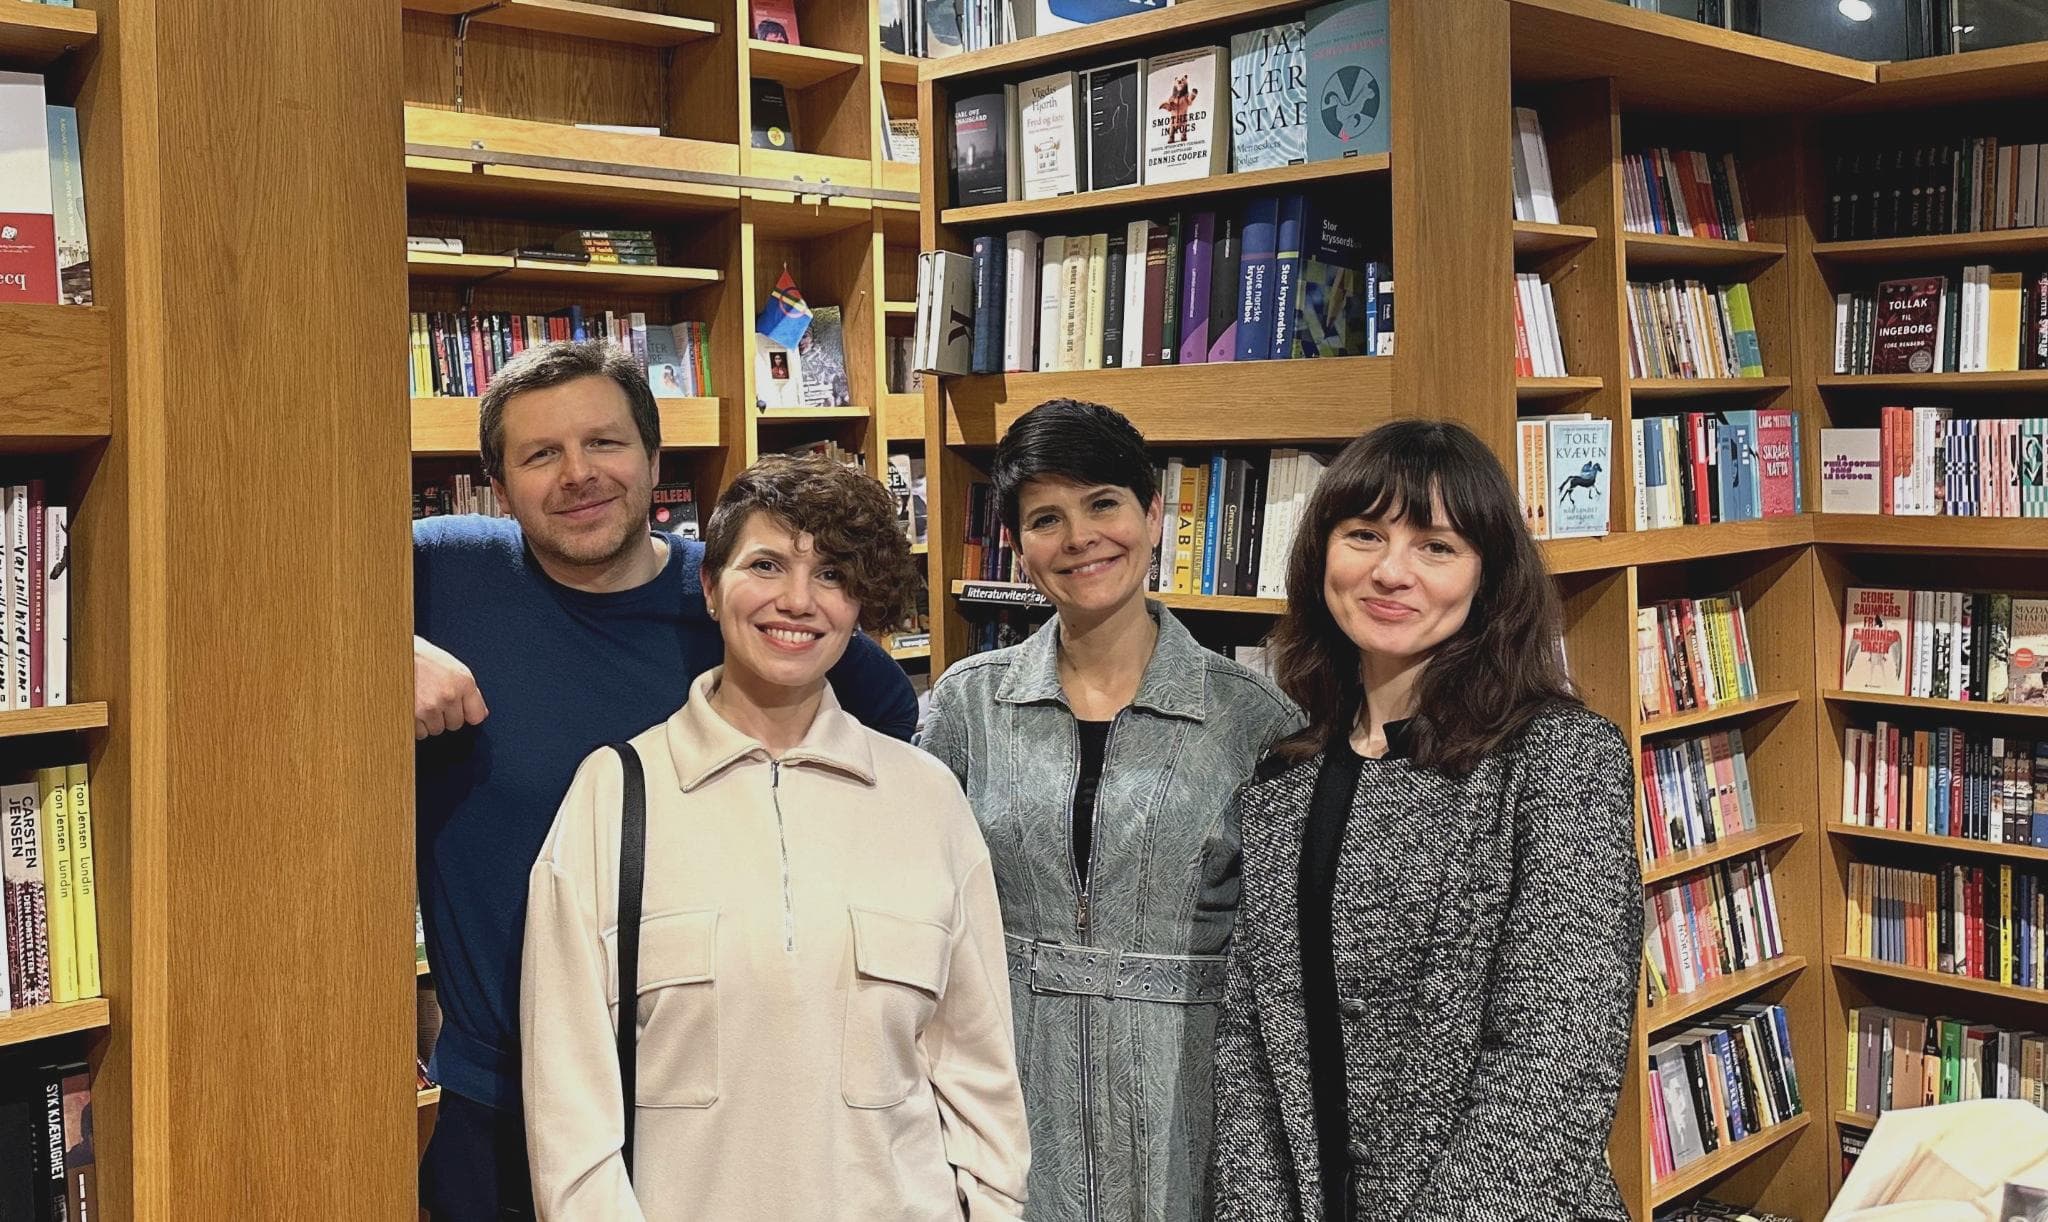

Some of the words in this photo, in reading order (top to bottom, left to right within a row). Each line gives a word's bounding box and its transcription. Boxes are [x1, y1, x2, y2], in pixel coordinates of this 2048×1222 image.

[1151, 111, 1207, 129] SMOTHERED
[1160, 125, 1170, 136] IN
[1148, 154, 1176, 168] DENNIS
[1176, 149, 1208, 164] COOPER
[1322, 219, 1338, 231] Stor
[1256, 264, 1265, 288] Store
[1281, 264, 1290, 284] Stor
[1244, 265, 1256, 324] kryssordbok
[1254, 291, 1262, 322] norske
[1889, 298, 1928, 310] TOLLAK
[1276, 286, 1288, 345] kryssordbok
[1879, 324, 1933, 337] INGEBORG
[1566, 433, 1598, 445] TORE
[1556, 447, 1608, 459] KVÆVEN
[652, 488, 692, 504] EILEEN
[1176, 502, 1192, 575] BABEL
[14, 546, 27, 573] Vær
[15, 576, 30, 608] snill
[1860, 591, 1894, 604] GEORGE
[16, 648, 30, 691] dyrene
[54, 783, 64, 809] Tron
[76, 782, 86, 806] Tron
[10, 798, 23, 858] JENSEN
[22, 796, 37, 868] CARSTEN
[56, 812, 66, 852] Jensen
[78, 811, 88, 849] Jensen
[60, 859, 69, 898] Lundin
[81, 856, 91, 895] Lundin
[25, 914, 33, 950] FØRSTE
[46, 1083, 58, 1108] SYK
[48, 1108, 64, 1180] KJÆRLIGHET
